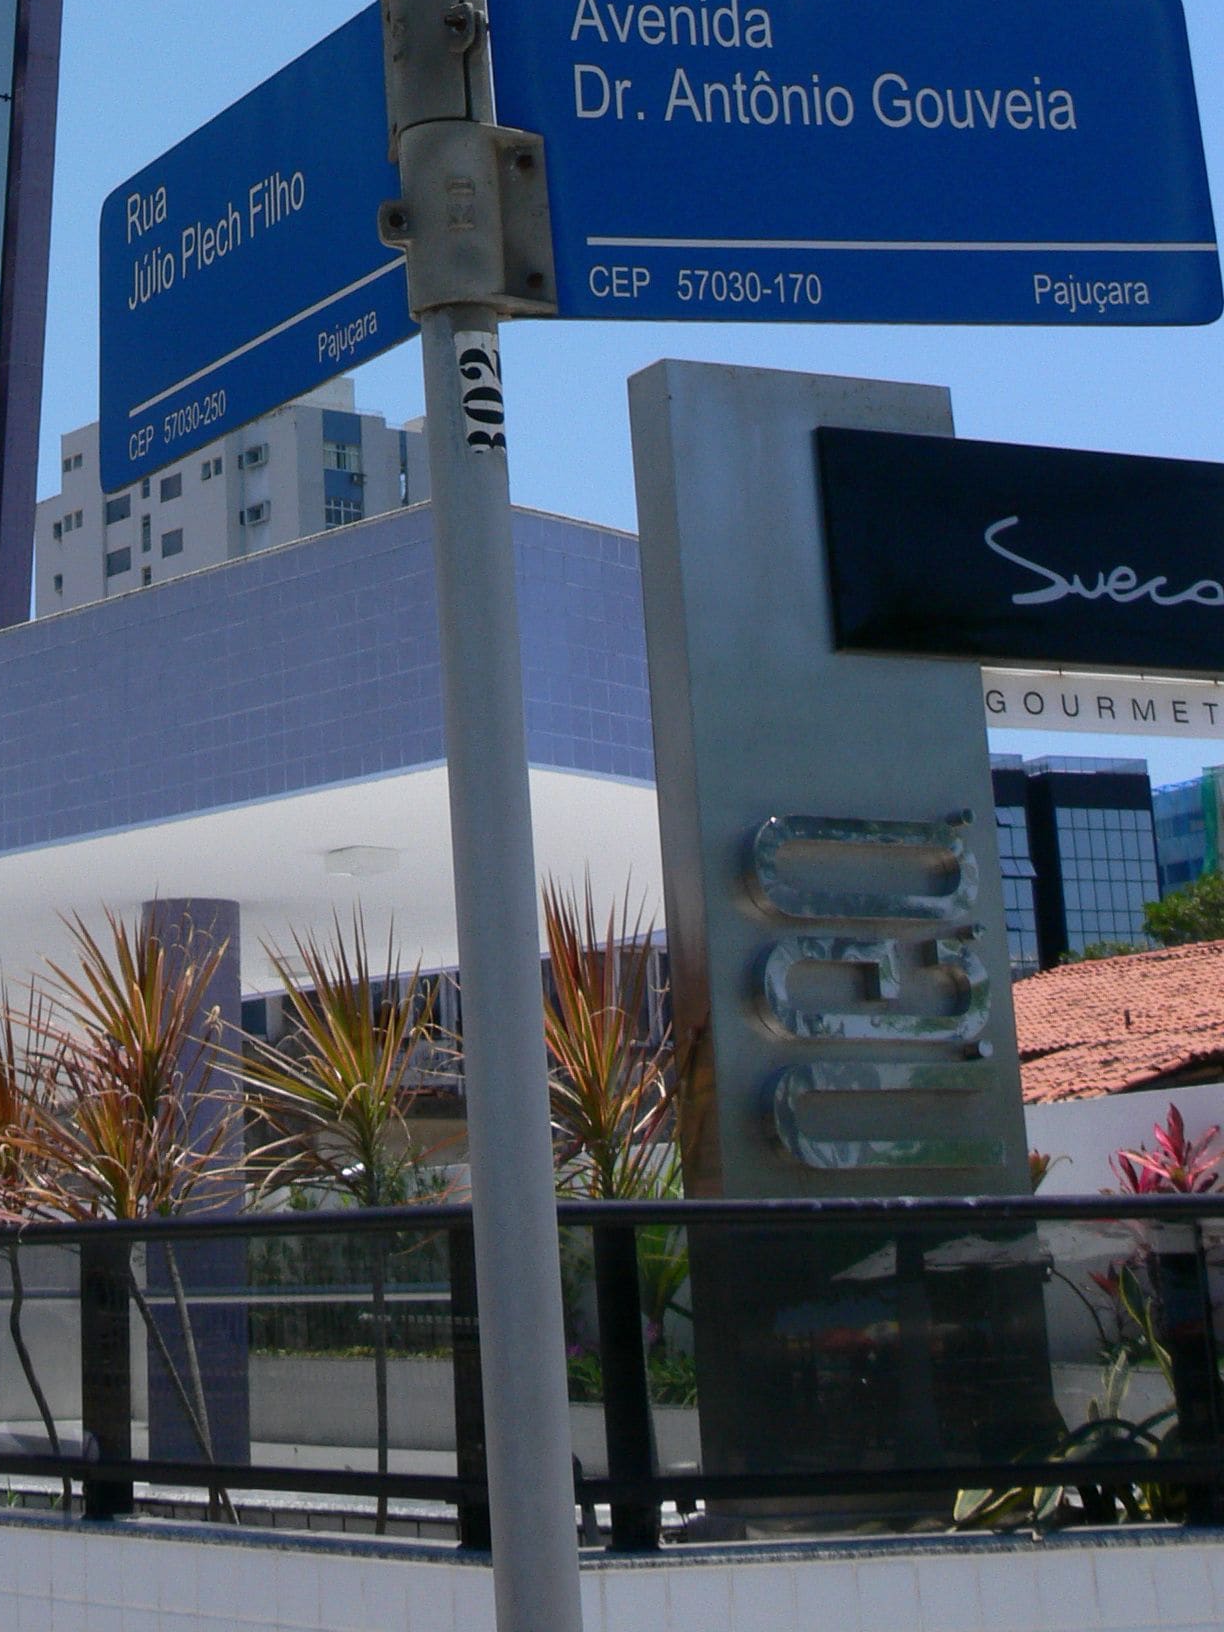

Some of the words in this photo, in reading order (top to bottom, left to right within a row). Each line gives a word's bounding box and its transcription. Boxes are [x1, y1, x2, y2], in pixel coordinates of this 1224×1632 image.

[573, 64, 646, 120] Dr.
[664, 68, 855, 127] Antônio
[872, 73, 1077, 130] Gouveia
[127, 186, 167, 245] Rua
[128, 246, 176, 310] Júlio
[181, 203, 242, 280] Plech
[248, 170, 305, 239] Filho
[589, 266, 650, 298] CEP
[676, 269, 822, 305] 57030-170
[1033, 274, 1150, 313] Pajuçara
[317, 310, 378, 363] Pajuçara
[128, 424, 155, 461] CEP
[163, 388, 227, 444] 57030-250
[984, 689, 1219, 725] GOURMET
